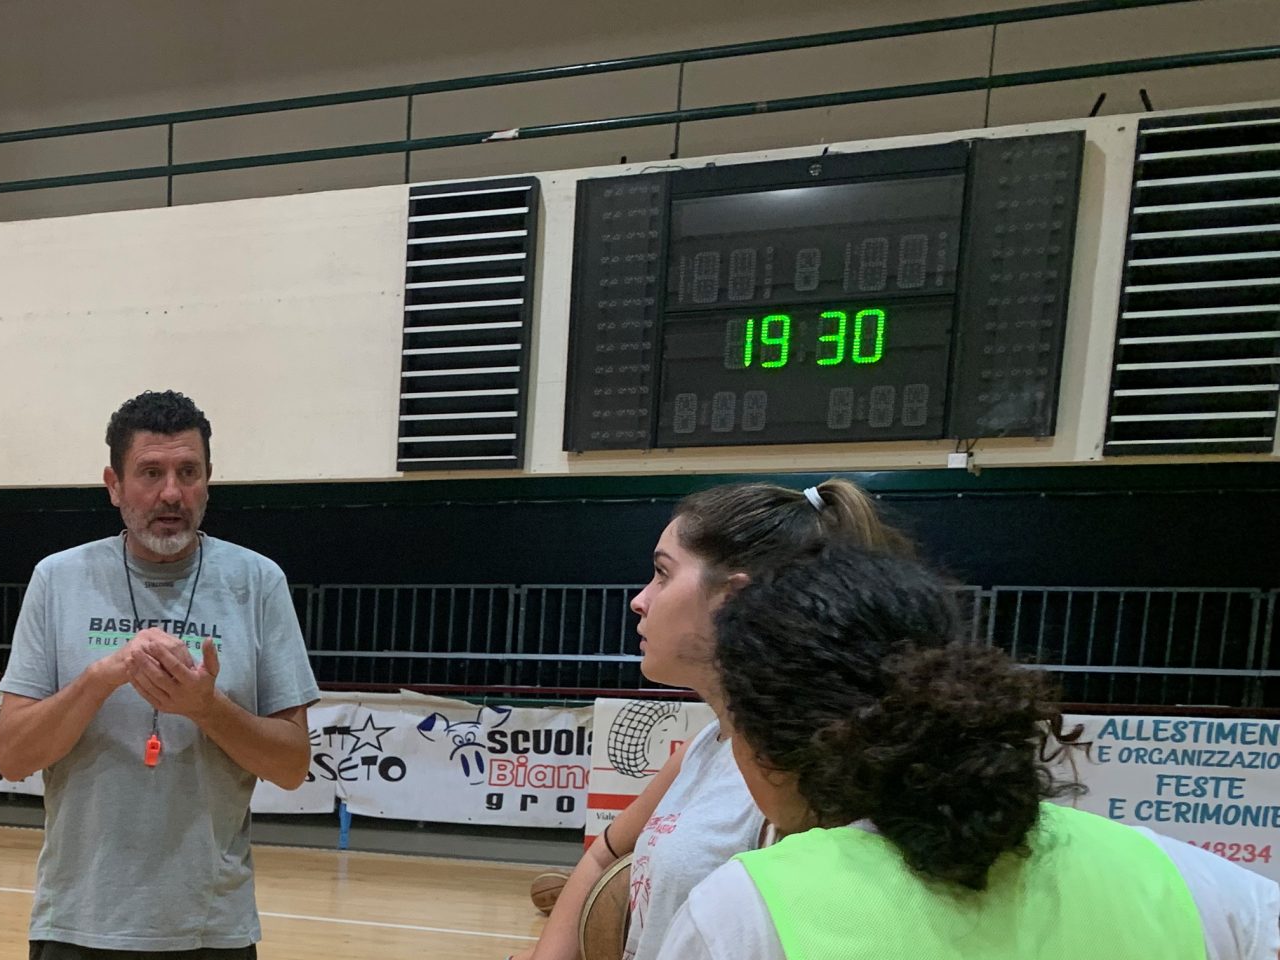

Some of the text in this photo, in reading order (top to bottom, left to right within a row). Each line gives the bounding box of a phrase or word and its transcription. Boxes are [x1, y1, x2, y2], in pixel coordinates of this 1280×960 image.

[744, 309, 885, 368] 19 30
[89, 617, 222, 639] BASKETBALL
[88, 636, 119, 646] TRUE
[1097, 746, 1112, 763] E
[1156, 774, 1246, 799] FESTE
[1108, 798, 1127, 820] E
